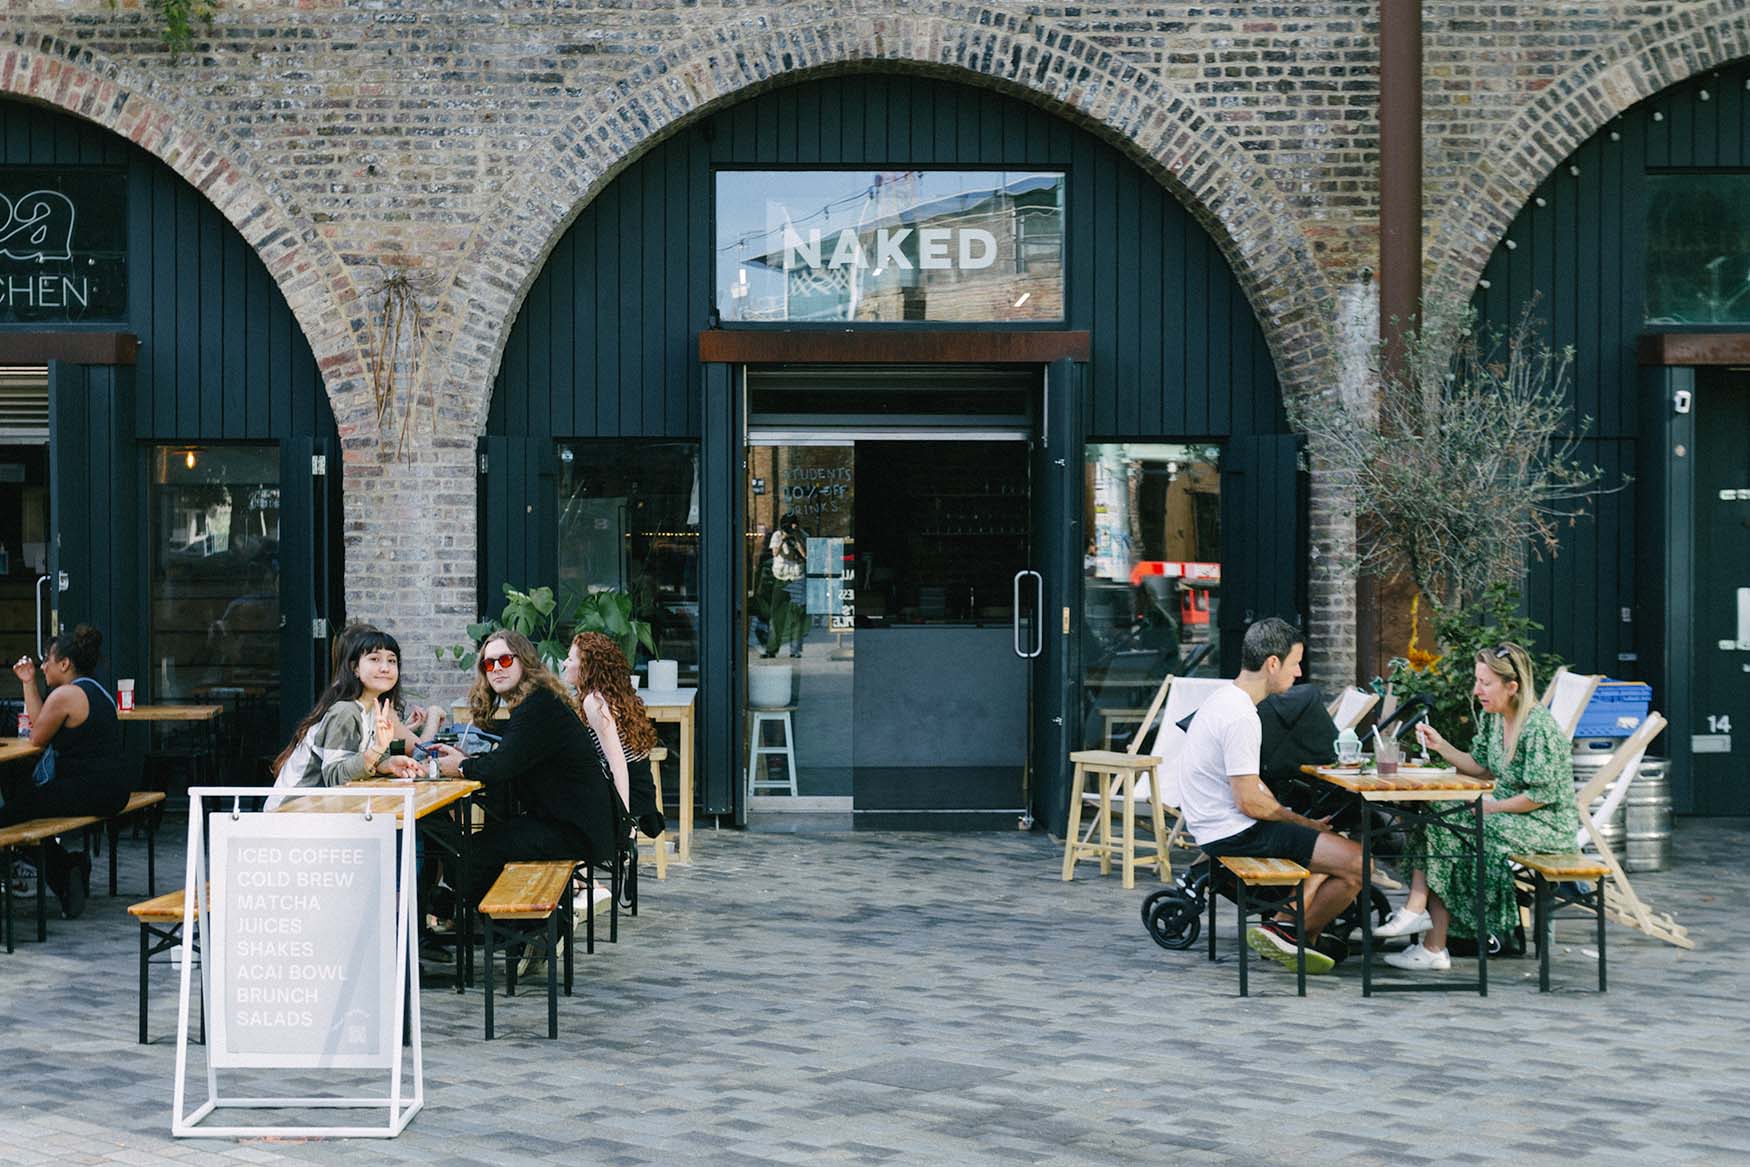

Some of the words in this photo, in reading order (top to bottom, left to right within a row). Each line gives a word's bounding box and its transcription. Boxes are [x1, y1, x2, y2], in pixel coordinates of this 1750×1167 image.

[784, 228, 998, 270] NAKED
[1706, 714, 1732, 733] 14
[237, 848, 282, 864] ICED
[288, 848, 364, 864] COFFEE
[237, 871, 290, 887] COLD
[296, 871, 354, 888] BREW
[237, 895, 321, 911] MATCHA
[237, 917, 303, 934] JUICES
[237, 941, 314, 957] SHAKES
[237, 965, 282, 980] ACAI
[288, 965, 347, 980] BOWL
[237, 987, 319, 1003] BRUNCH
[237, 1011, 313, 1027] SALADS
